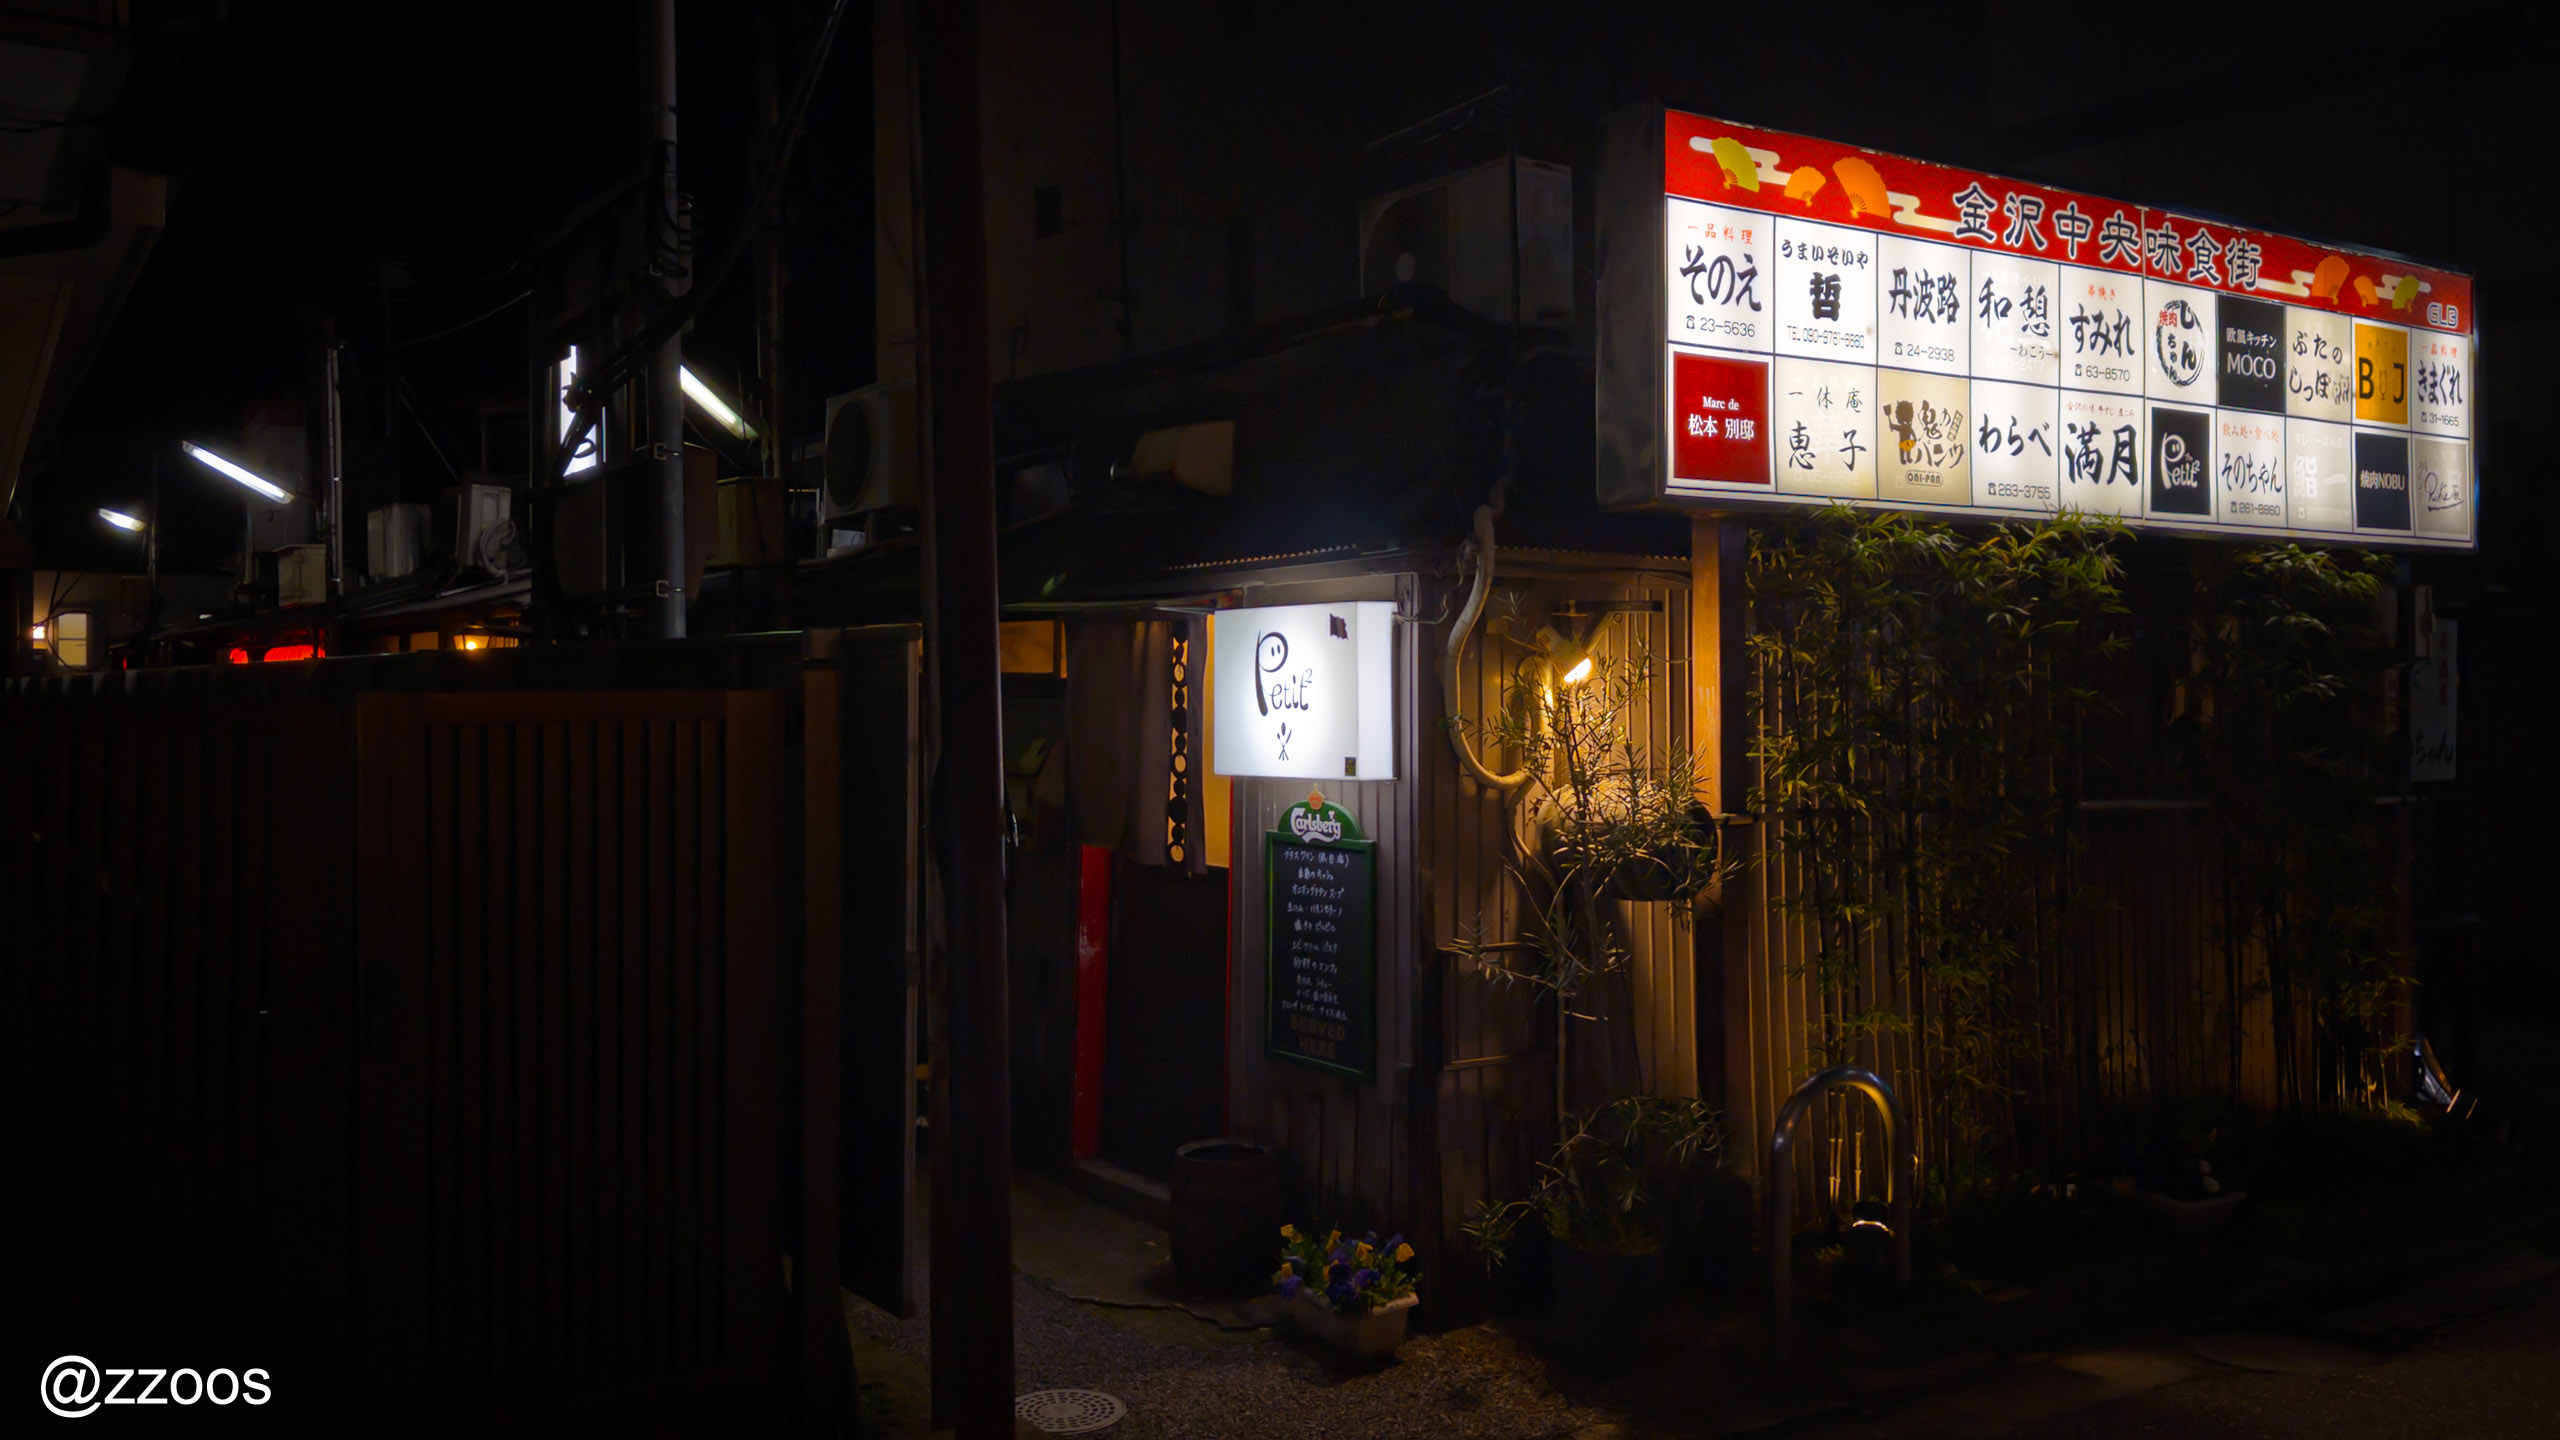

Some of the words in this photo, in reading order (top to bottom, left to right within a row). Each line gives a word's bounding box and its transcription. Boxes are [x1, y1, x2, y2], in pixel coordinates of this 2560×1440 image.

[1687, 223, 1753, 246] 一品料理
[1953, 181, 2262, 290] 金沢中央味食街
[1680, 245, 1761, 312] そのえ
[1810, 272, 1842, 322] 哲
[1888, 266, 1960, 325] 丹波路
[1701, 318, 1756, 338] 23-5636
[1787, 325, 1801, 341] TEL
[2069, 302, 2135, 359] すみれ
[2159, 310, 2178, 328] 焼肉
[1907, 343, 1955, 362] 24-2938
[2226, 327, 2277, 348] 欧風キッチン
[2292, 330, 2343, 364] ぶたの
[2086, 365, 2131, 382] 63-8570
[2227, 352, 2276, 379] MOCO
[2418, 360, 2463, 406] きまぐれ
[1702, 395, 1725, 409] Marc
[1728, 398, 1739, 411] de
[1788, 385, 1863, 413] 一休庵
[1688, 412, 1718, 438] 松本
[1725, 417, 1754, 441] 別邸
[1978, 413, 2052, 457] わらべ
[1788, 420, 1866, 471] 恵子
[2065, 421, 2138, 486] 満月
[2221, 452, 2282, 494] そのちゃん
[1998, 483, 2051, 500] 263-3755
[1290, 807, 1342, 842] Carlsberg
